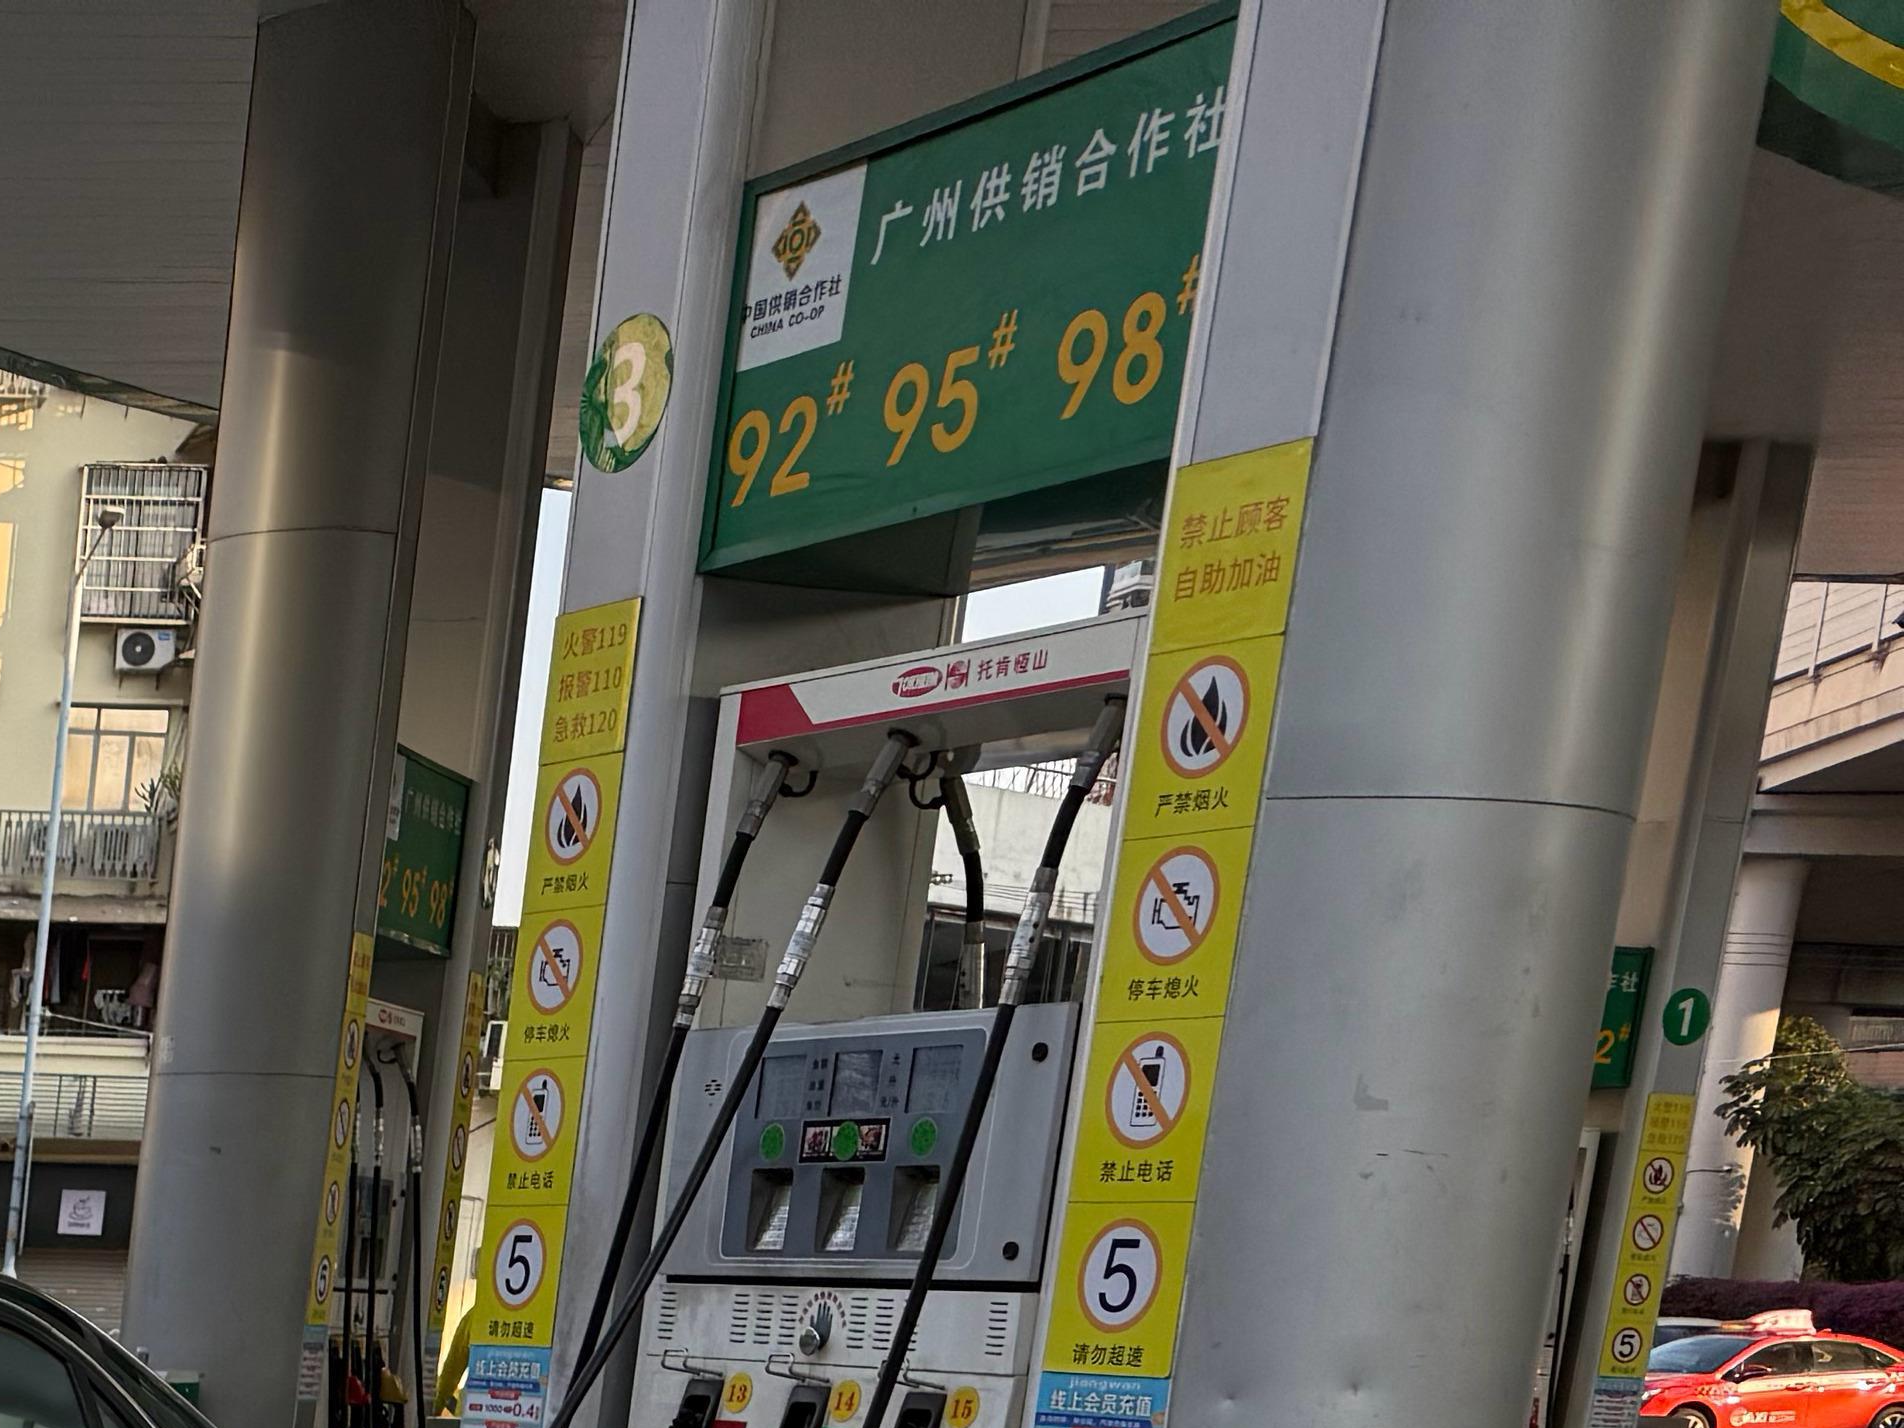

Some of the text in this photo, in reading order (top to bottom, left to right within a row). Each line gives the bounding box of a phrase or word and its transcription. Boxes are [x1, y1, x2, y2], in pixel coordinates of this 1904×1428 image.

[871, 86, 1227, 266] 广州供销合作社
[742, 274, 842, 324] 中国供销合作社
[750, 305, 825, 339] CHINA CO-OP
[728, 359, 854, 509] 92#
[884, 310, 1018, 467] 95#
[1180, 495, 1290, 549] 禁止顾客
[1174, 549, 1280, 602] 自助加油
[563, 624, 627, 660] 火警119
[557, 666, 622, 703] 报警110
[553, 708, 617, 743] 急救120
[1154, 786, 1229, 818] 严禁烟火
[541, 872, 589, 895] 严禁烟火
[1127, 975, 1200, 1001] 停车熄火
[1677, 997, 1695, 1036] 1
[524, 1023, 570, 1043] 停车熄火
[507, 1170, 554, 1189] 禁止电话
[1100, 1160, 1174, 1183] 禁止电话
[505, 1235, 533, 1295] 5
[1098, 1238, 1141, 1313] 5
[489, 1320, 534, 1339] 请勿超速
[1072, 1343, 1144, 1367] 请勿超速
[1619, 1334, 1636, 1358] 5
[728, 1384, 747, 1402] 13
[834, 1391, 854, 1412] 14
[951, 1399, 973, 1419] 15
[1050, 1390, 1153, 1417] 线上会员充值
